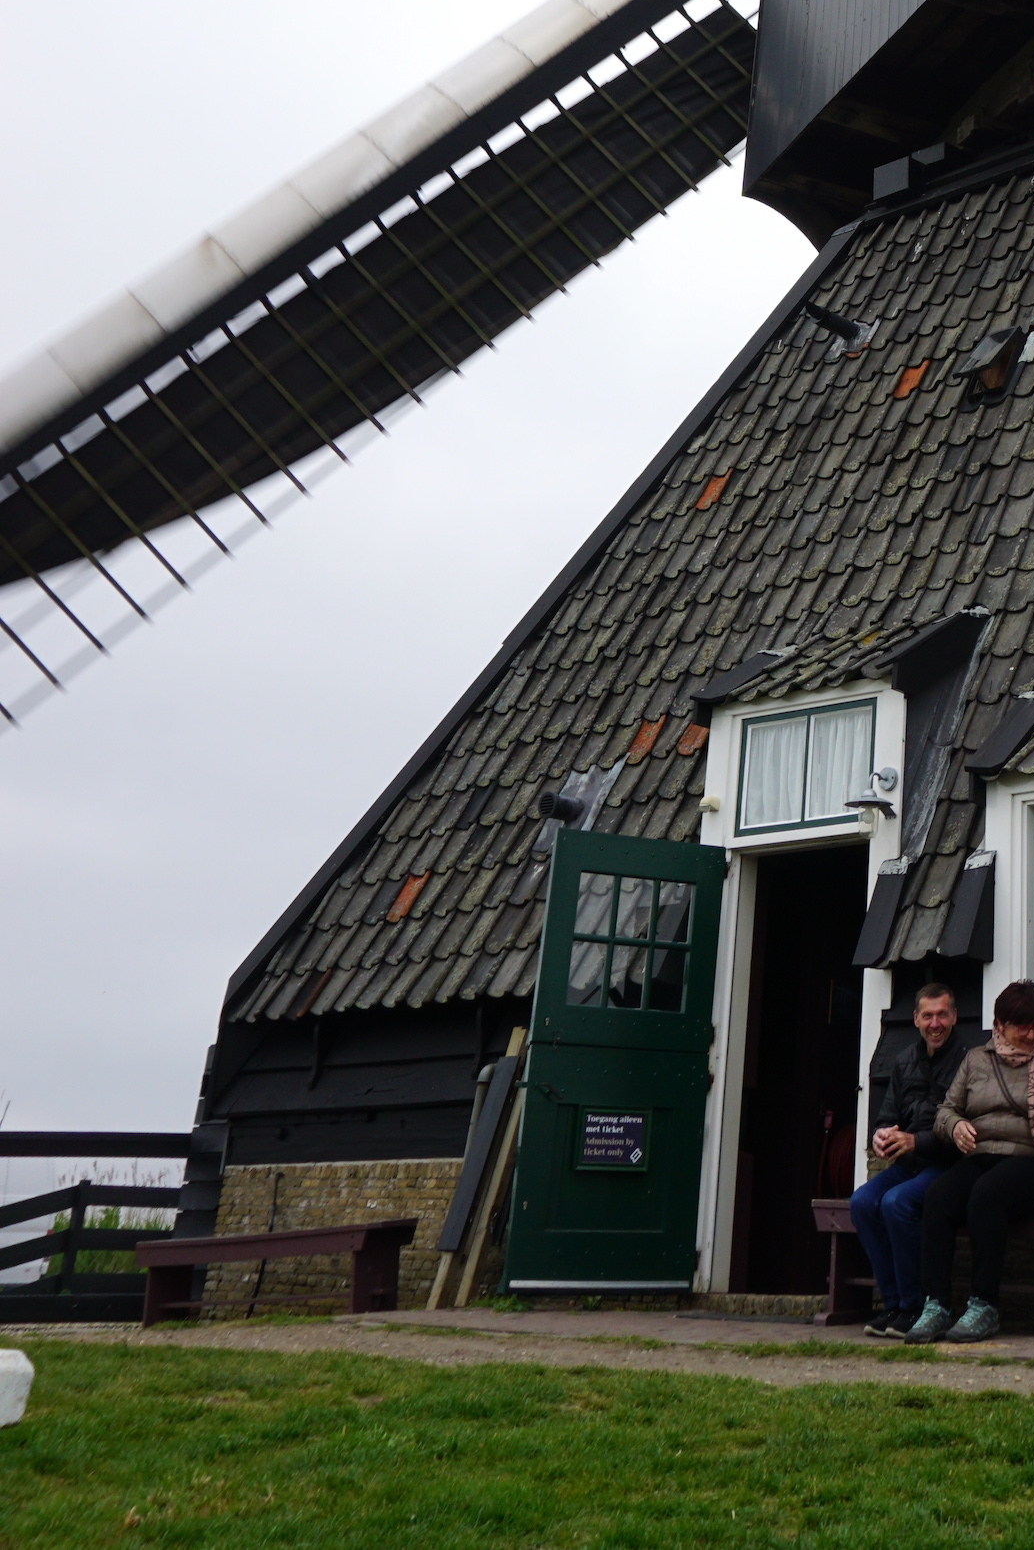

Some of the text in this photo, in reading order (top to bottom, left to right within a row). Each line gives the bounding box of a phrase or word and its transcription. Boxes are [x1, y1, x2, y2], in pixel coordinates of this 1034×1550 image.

[586, 1114, 643, 1124] Toegang alleen
[585, 1125, 624, 1133] met ticket
[584, 1137, 635, 1147] Admission by
[583, 1148, 624, 1157] ticket only
